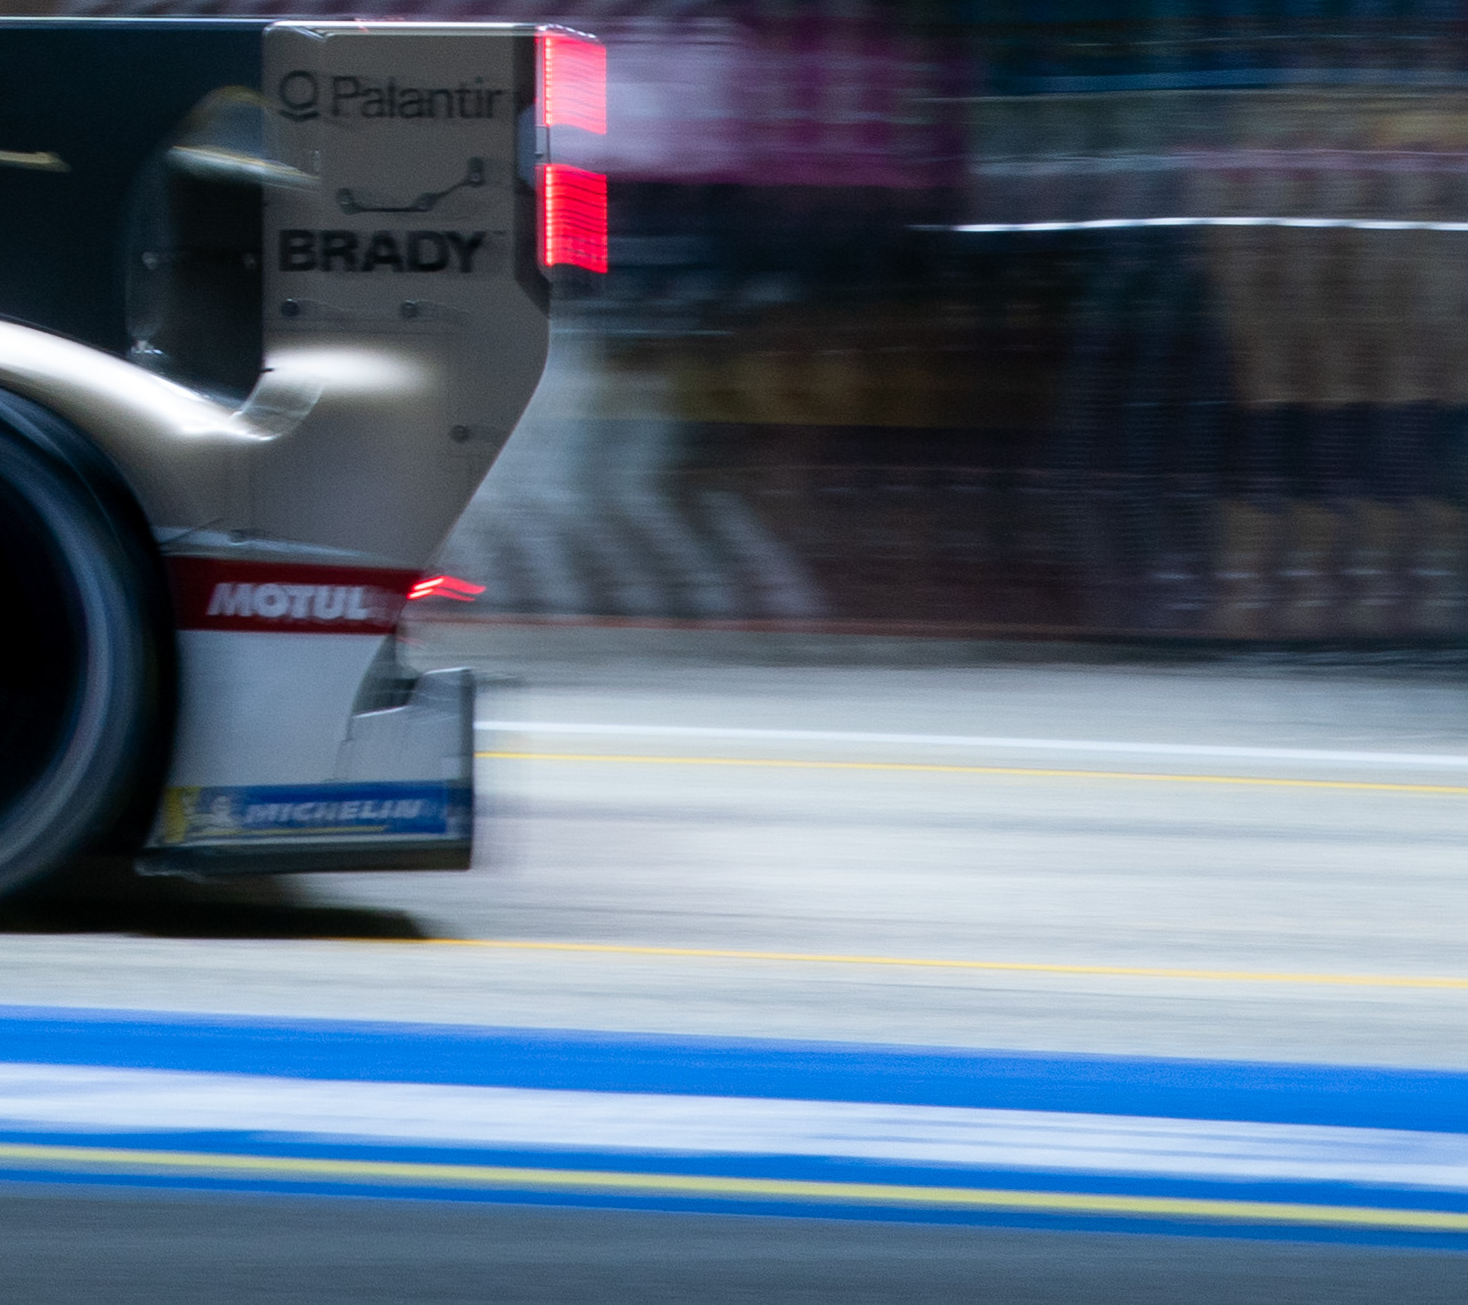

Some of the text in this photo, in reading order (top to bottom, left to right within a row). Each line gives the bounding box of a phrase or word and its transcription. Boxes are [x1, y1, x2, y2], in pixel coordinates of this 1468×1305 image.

[332, 76, 502, 119] Palantir
[278, 229, 486, 273] BRADY
[207, 583, 370, 621] MOTUL
[243, 798, 425, 824] MICHELIN
